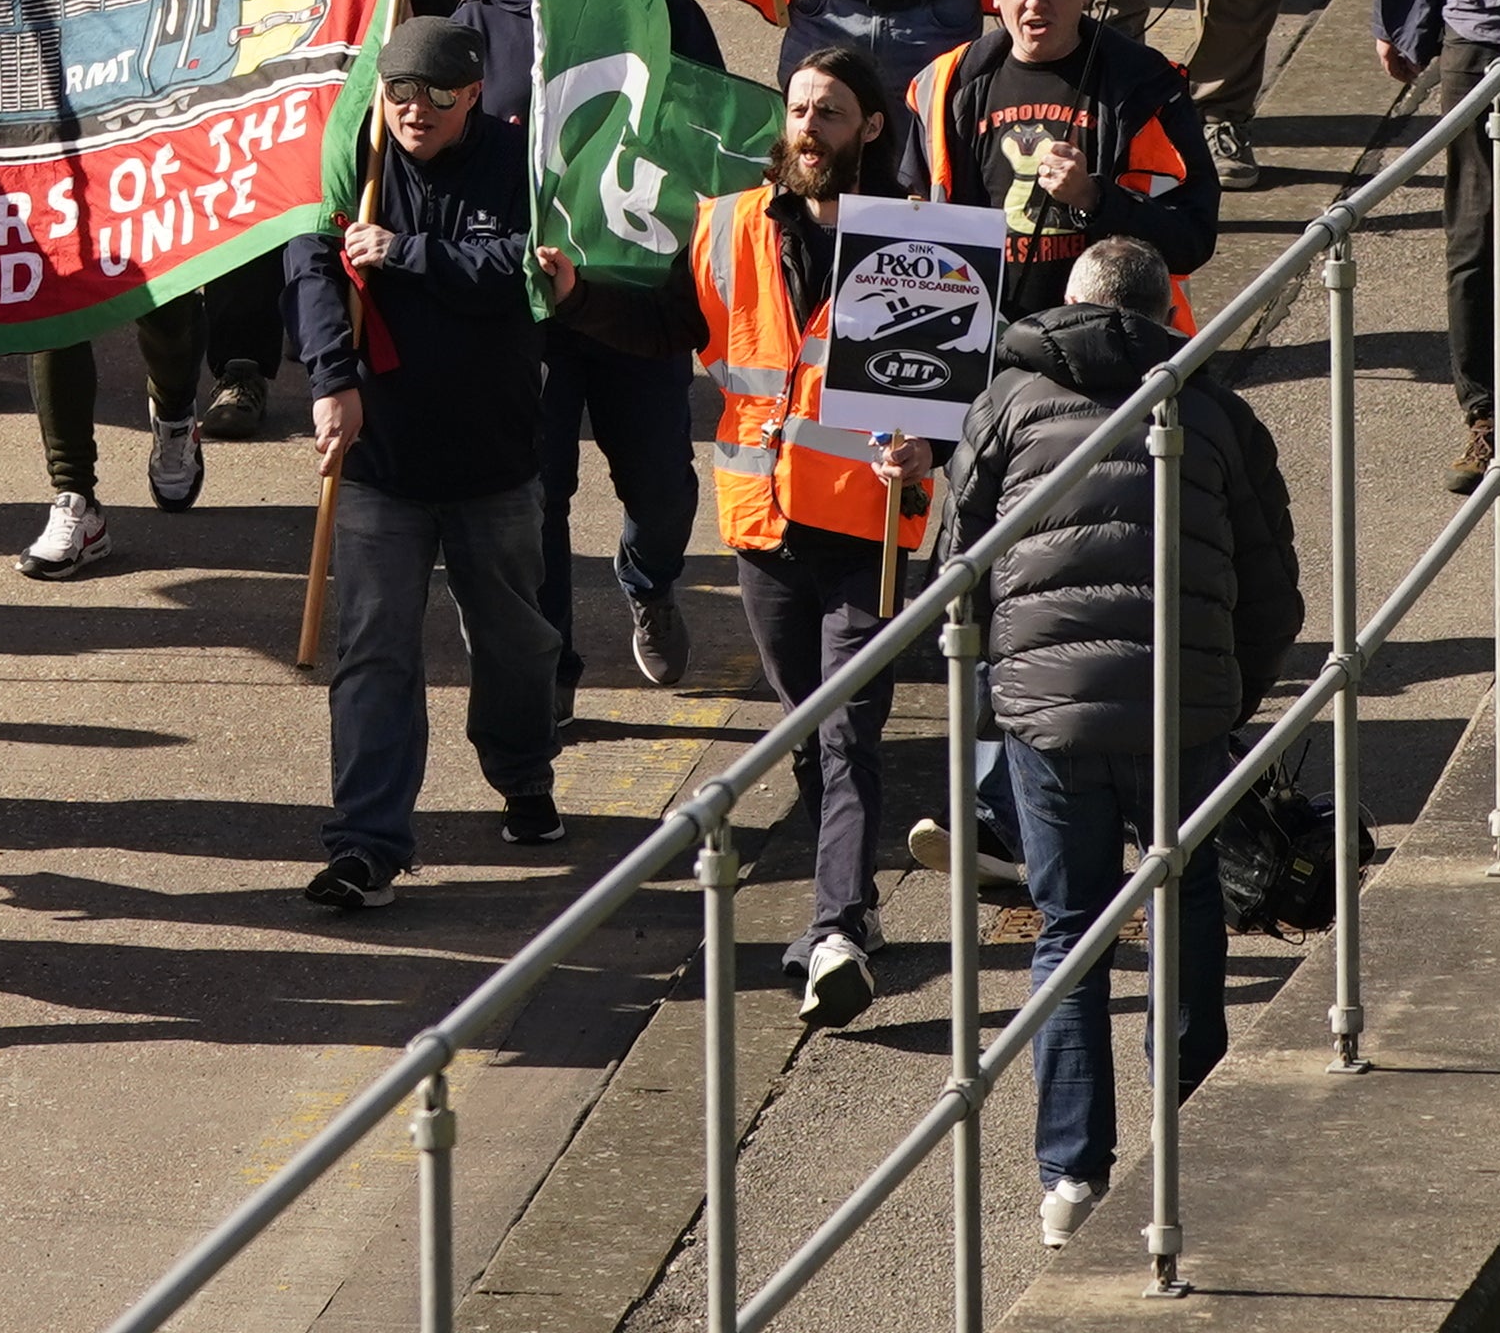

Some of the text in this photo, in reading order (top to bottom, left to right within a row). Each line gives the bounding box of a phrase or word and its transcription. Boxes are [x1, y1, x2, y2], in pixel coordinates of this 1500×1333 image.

[65, 48, 136, 95] RMT
[109, 143, 180, 213] OF
[208, 90, 313, 174] THE
[100, 162, 258, 277] UNITE
[908, 243, 934, 255] SINK
[874, 252, 934, 279] P&O
[855, 274, 980, 296] SAY NO TO SCABBING
[885, 361, 935, 380] RMT
